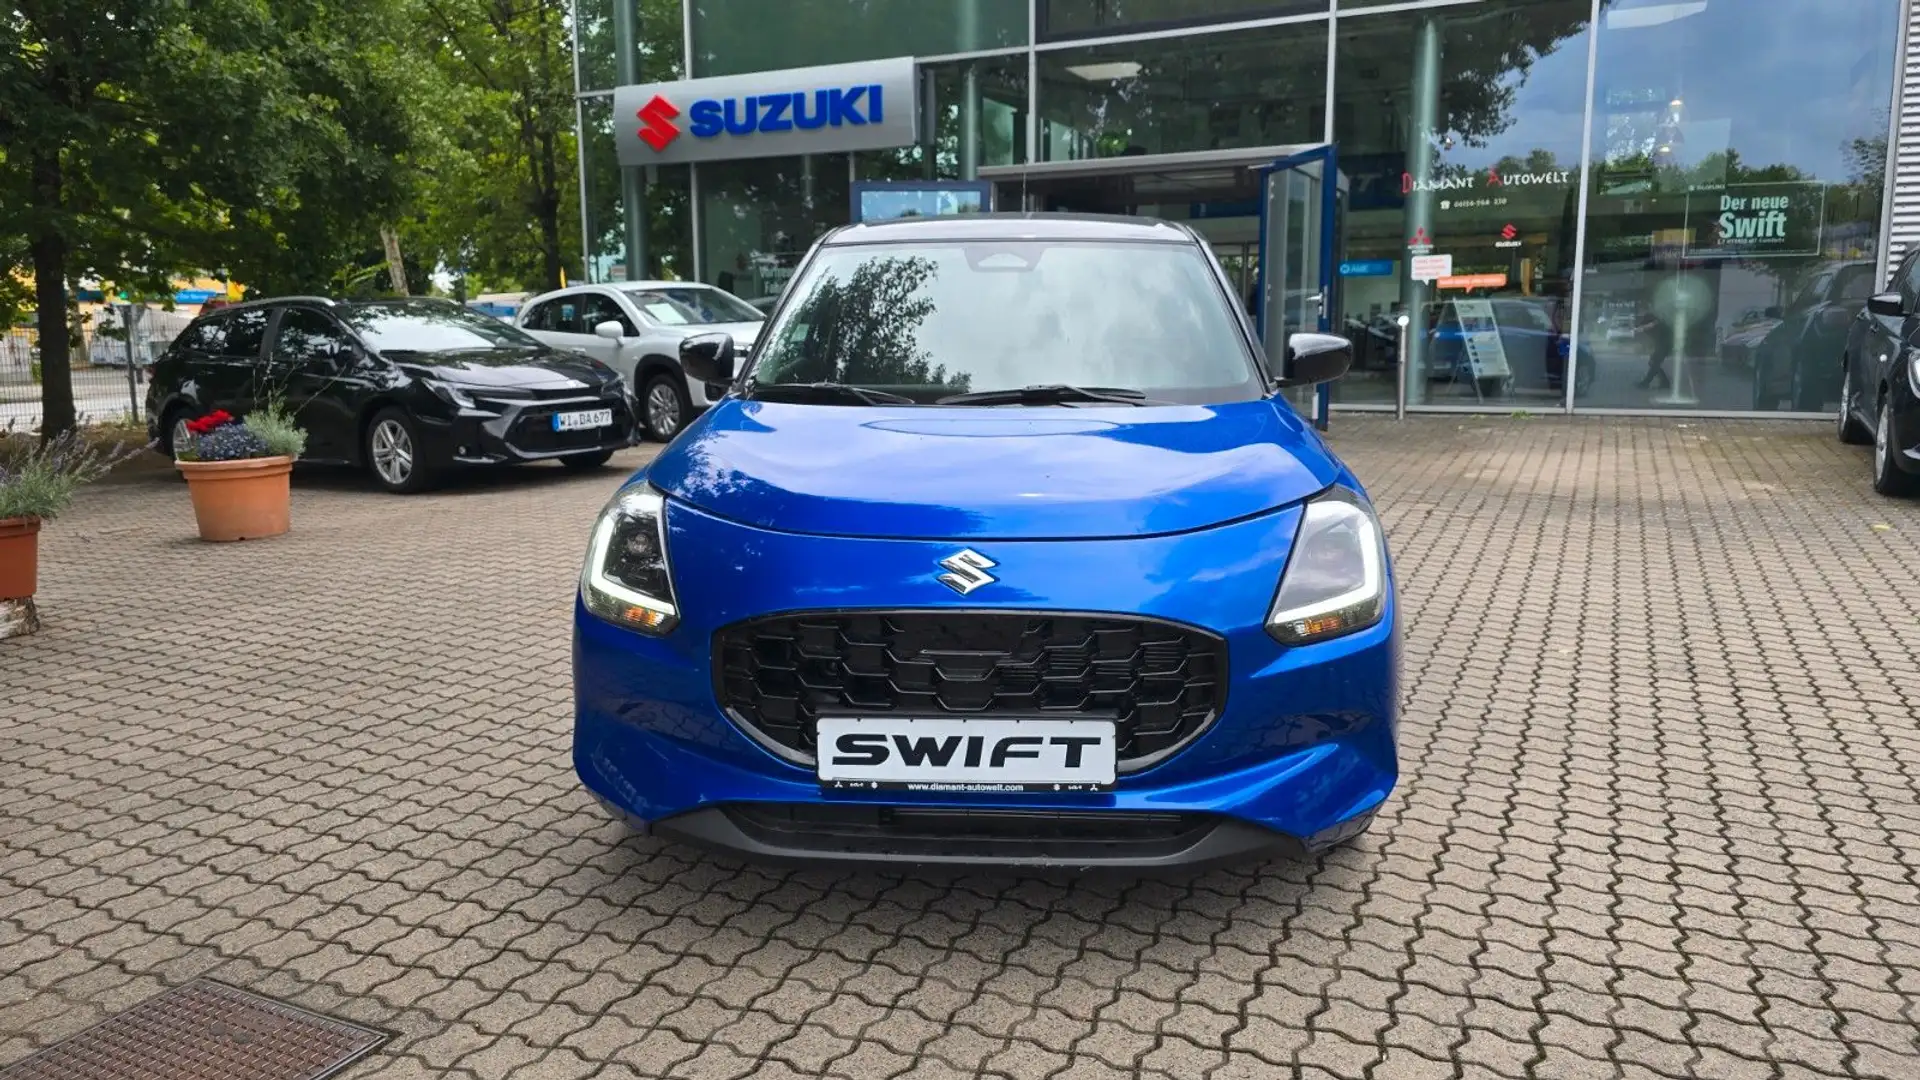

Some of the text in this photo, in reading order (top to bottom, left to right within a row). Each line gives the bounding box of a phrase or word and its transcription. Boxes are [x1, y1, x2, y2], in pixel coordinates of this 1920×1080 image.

[689, 84, 883, 138] SUZUKI
[1401, 172, 1475, 193] DIAMANT
[1486, 165, 1569, 188] AUTOWELT
[1720, 195, 1789, 211] Der neue
[1718, 210, 1787, 239] Swift
[579, 413, 592, 425] DA
[593, 411, 610, 424] 677
[832, 733, 1101, 768] SWIFT
[908, 782, 1024, 792] www.diamant-autowelt.com
